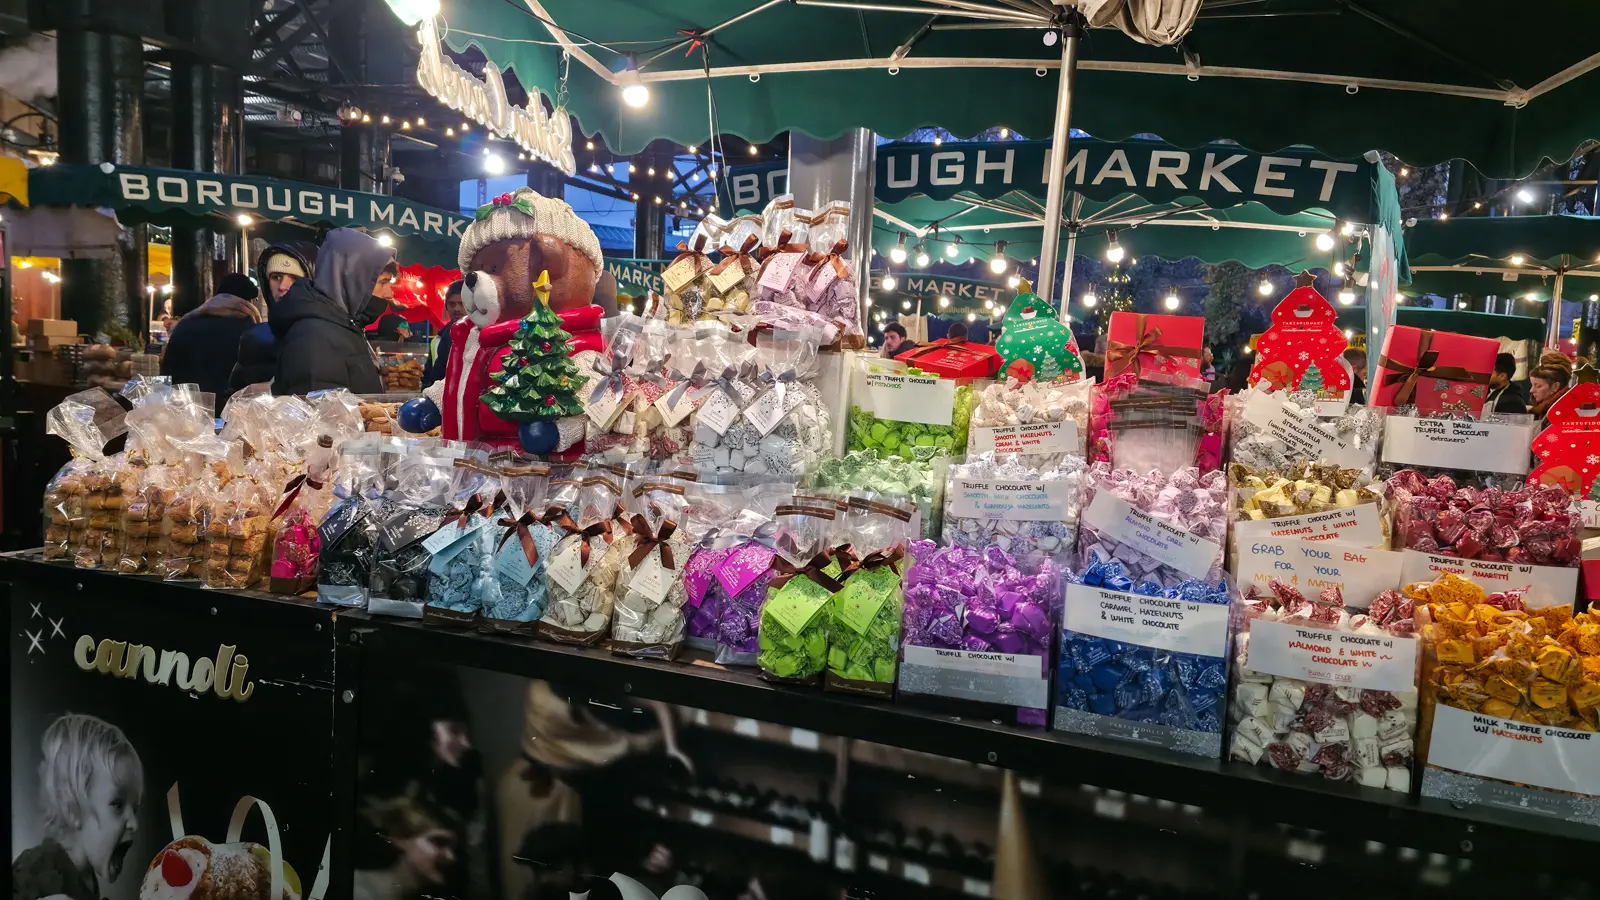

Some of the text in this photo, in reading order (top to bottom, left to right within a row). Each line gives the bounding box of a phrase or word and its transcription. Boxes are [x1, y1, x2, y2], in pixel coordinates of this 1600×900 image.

[1042, 149, 1358, 202] MARKET
[119, 173, 354, 219] BOROUGH
[609, 262, 662, 292] MARKE
[907, 278, 1005, 301] MARKET
[884, 375, 905, 383] TRUFFLE
[908, 377, 937, 385] CHOCOLATE
[991, 426, 1016, 434] TRUFFLE
[1019, 424, 1049, 432] CHOCOLATE
[1281, 407, 1304, 424] TRUFFLE
[1307, 423, 1336, 442] CHOCOLATE
[1413, 426, 1490, 437] TRUFFLE CHOCOLATE
[1418, 420, 1473, 430] EXTRA DARK
[1271, 429, 1319, 460] CHOCOLATE PIECES
[1287, 432, 1313, 449] CHOCOLATE
[961, 481, 989, 490] TRUFFLE
[995, 484, 1032, 492] CHOCOLATE
[1016, 492, 1049, 500] CHOCOLATE
[1124, 515, 1151, 533] ALMOND
[1129, 507, 1153, 524] TRUFFLE
[1157, 521, 1187, 539] CHOCOLATE
[1271, 519, 1301, 528] TRUFFLE
[1307, 511, 1342, 523] CHOCOLATE
[1271, 526, 1313, 537] HAZELNUTS
[1333, 520, 1358, 529] WHITE
[1135, 530, 1169, 551] CHOCOLATE
[1251, 543, 1368, 563] GRAB YOUR BAG
[1274, 561, 1342, 577] FOR YOUR
[1428, 556, 1465, 566] TRUFFLE
[1470, 561, 1514, 572] CHOCOLATE
[1099, 592, 1132, 603] TRUFFLE
[1139, 598, 1181, 610] CHOCOLATE
[1101, 611, 1180, 631] & WHITE CHOCOLATE
[1139, 608, 1184, 620] HAZELNUTS
[1296, 630, 1333, 642] TRUFFLE
[1340, 635, 1381, 647] CHOCOLATE
[935, 649, 962, 658] TRUFFLE
[967, 653, 1002, 661] CHOCOLATE
[1311, 655, 1359, 667] CHOCOLATE
[1350, 649, 1377, 658] WHITE
[74, 634, 254, 702] cannoli
[1473, 715, 1592, 740] MILK TRUFFLE CHOCOLATE
[1492, 728, 1543, 744] HAZELNUTS
